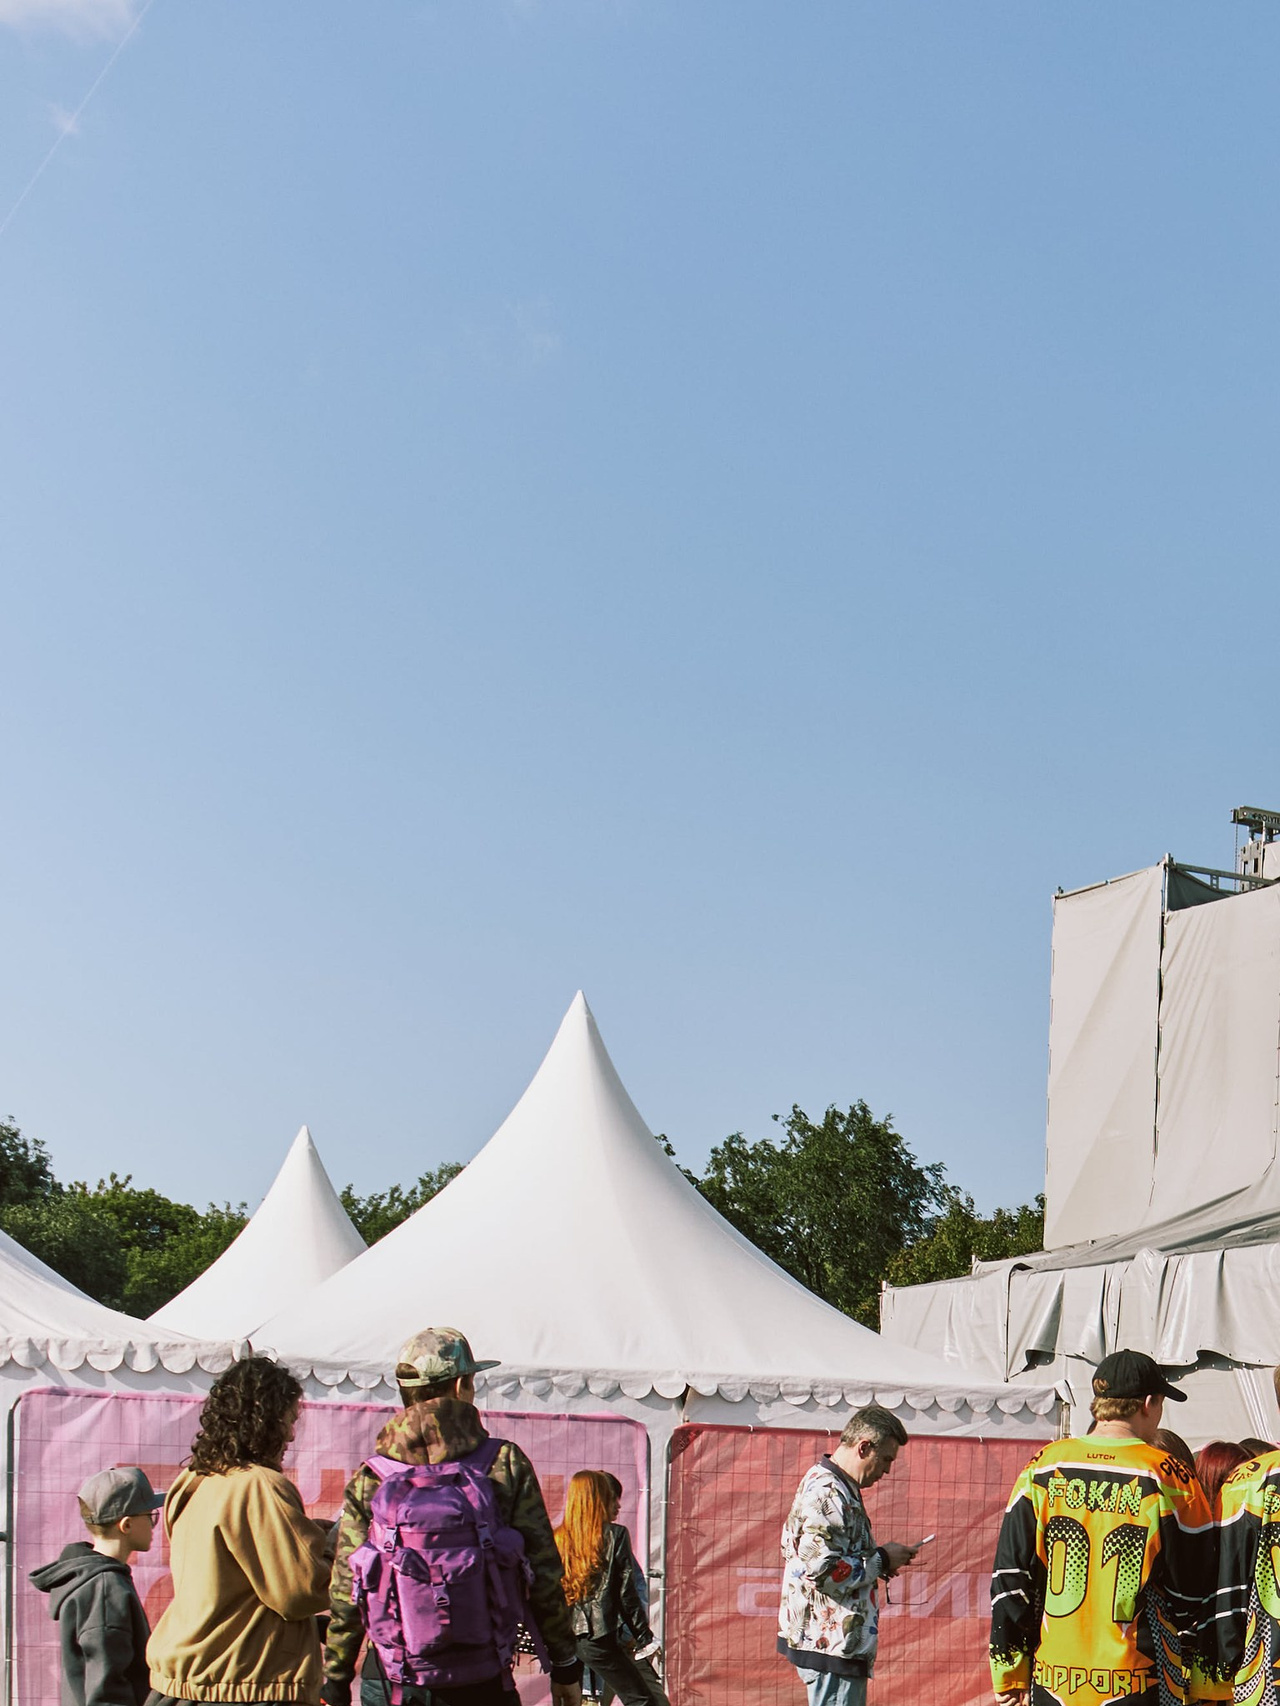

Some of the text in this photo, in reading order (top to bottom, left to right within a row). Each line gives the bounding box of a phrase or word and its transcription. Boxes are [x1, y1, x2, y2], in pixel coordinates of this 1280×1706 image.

[1254, 812, 1280, 824] PROLYTE
[1086, 1453, 1116, 1461] LUTCH
[1047, 1477, 1143, 1517] FOKIN
[1043, 1515, 1149, 1623] 01
[1033, 1660, 1150, 1697] SUPPORT
